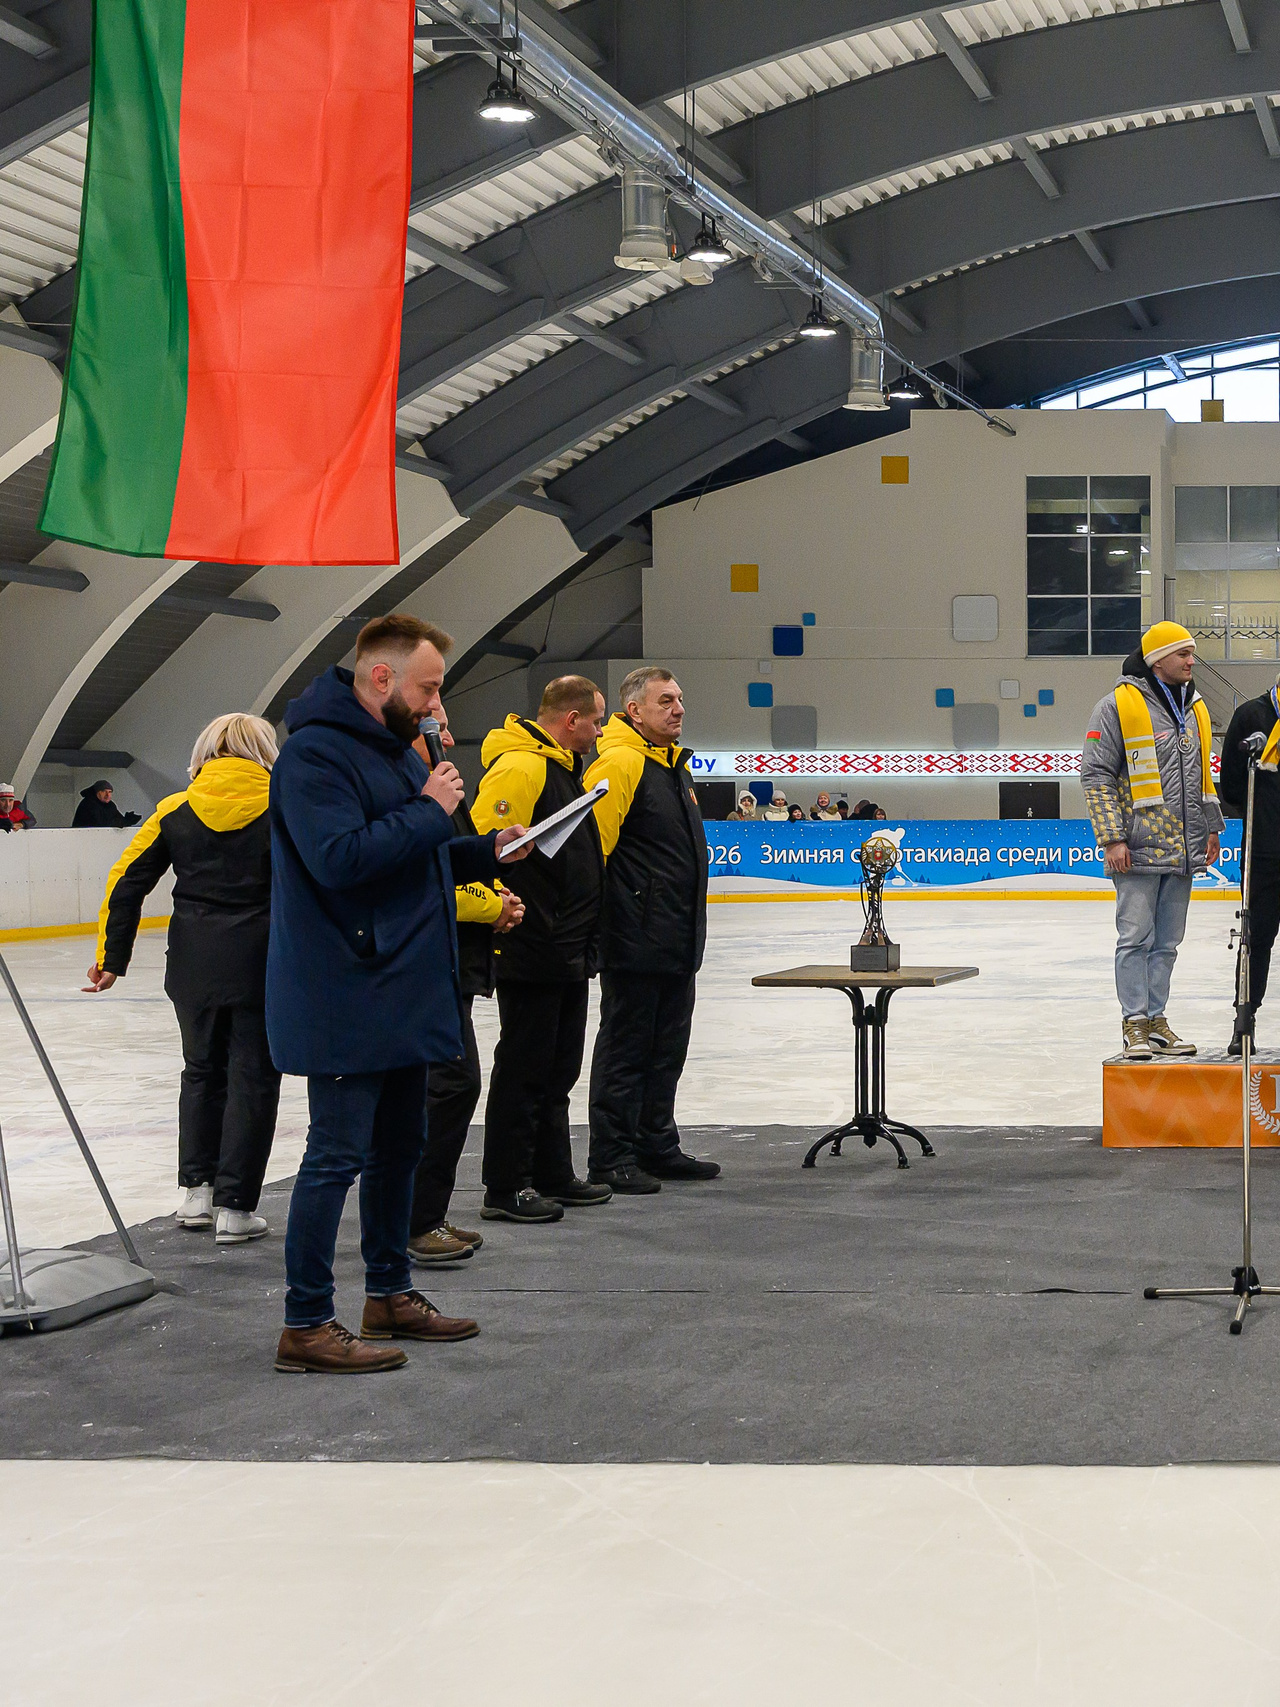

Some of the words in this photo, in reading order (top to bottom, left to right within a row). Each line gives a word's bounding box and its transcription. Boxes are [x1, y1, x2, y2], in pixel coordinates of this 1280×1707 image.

[691, 755, 717, 773] by
[706, 844, 742, 866] 026
[760, 844, 844, 865] Зимняя
[850, 846, 991, 867] стакиада
[996, 846, 1062, 867] среди
[1068, 841, 1105, 867] раб
[455, 884, 487, 901] ARUS
